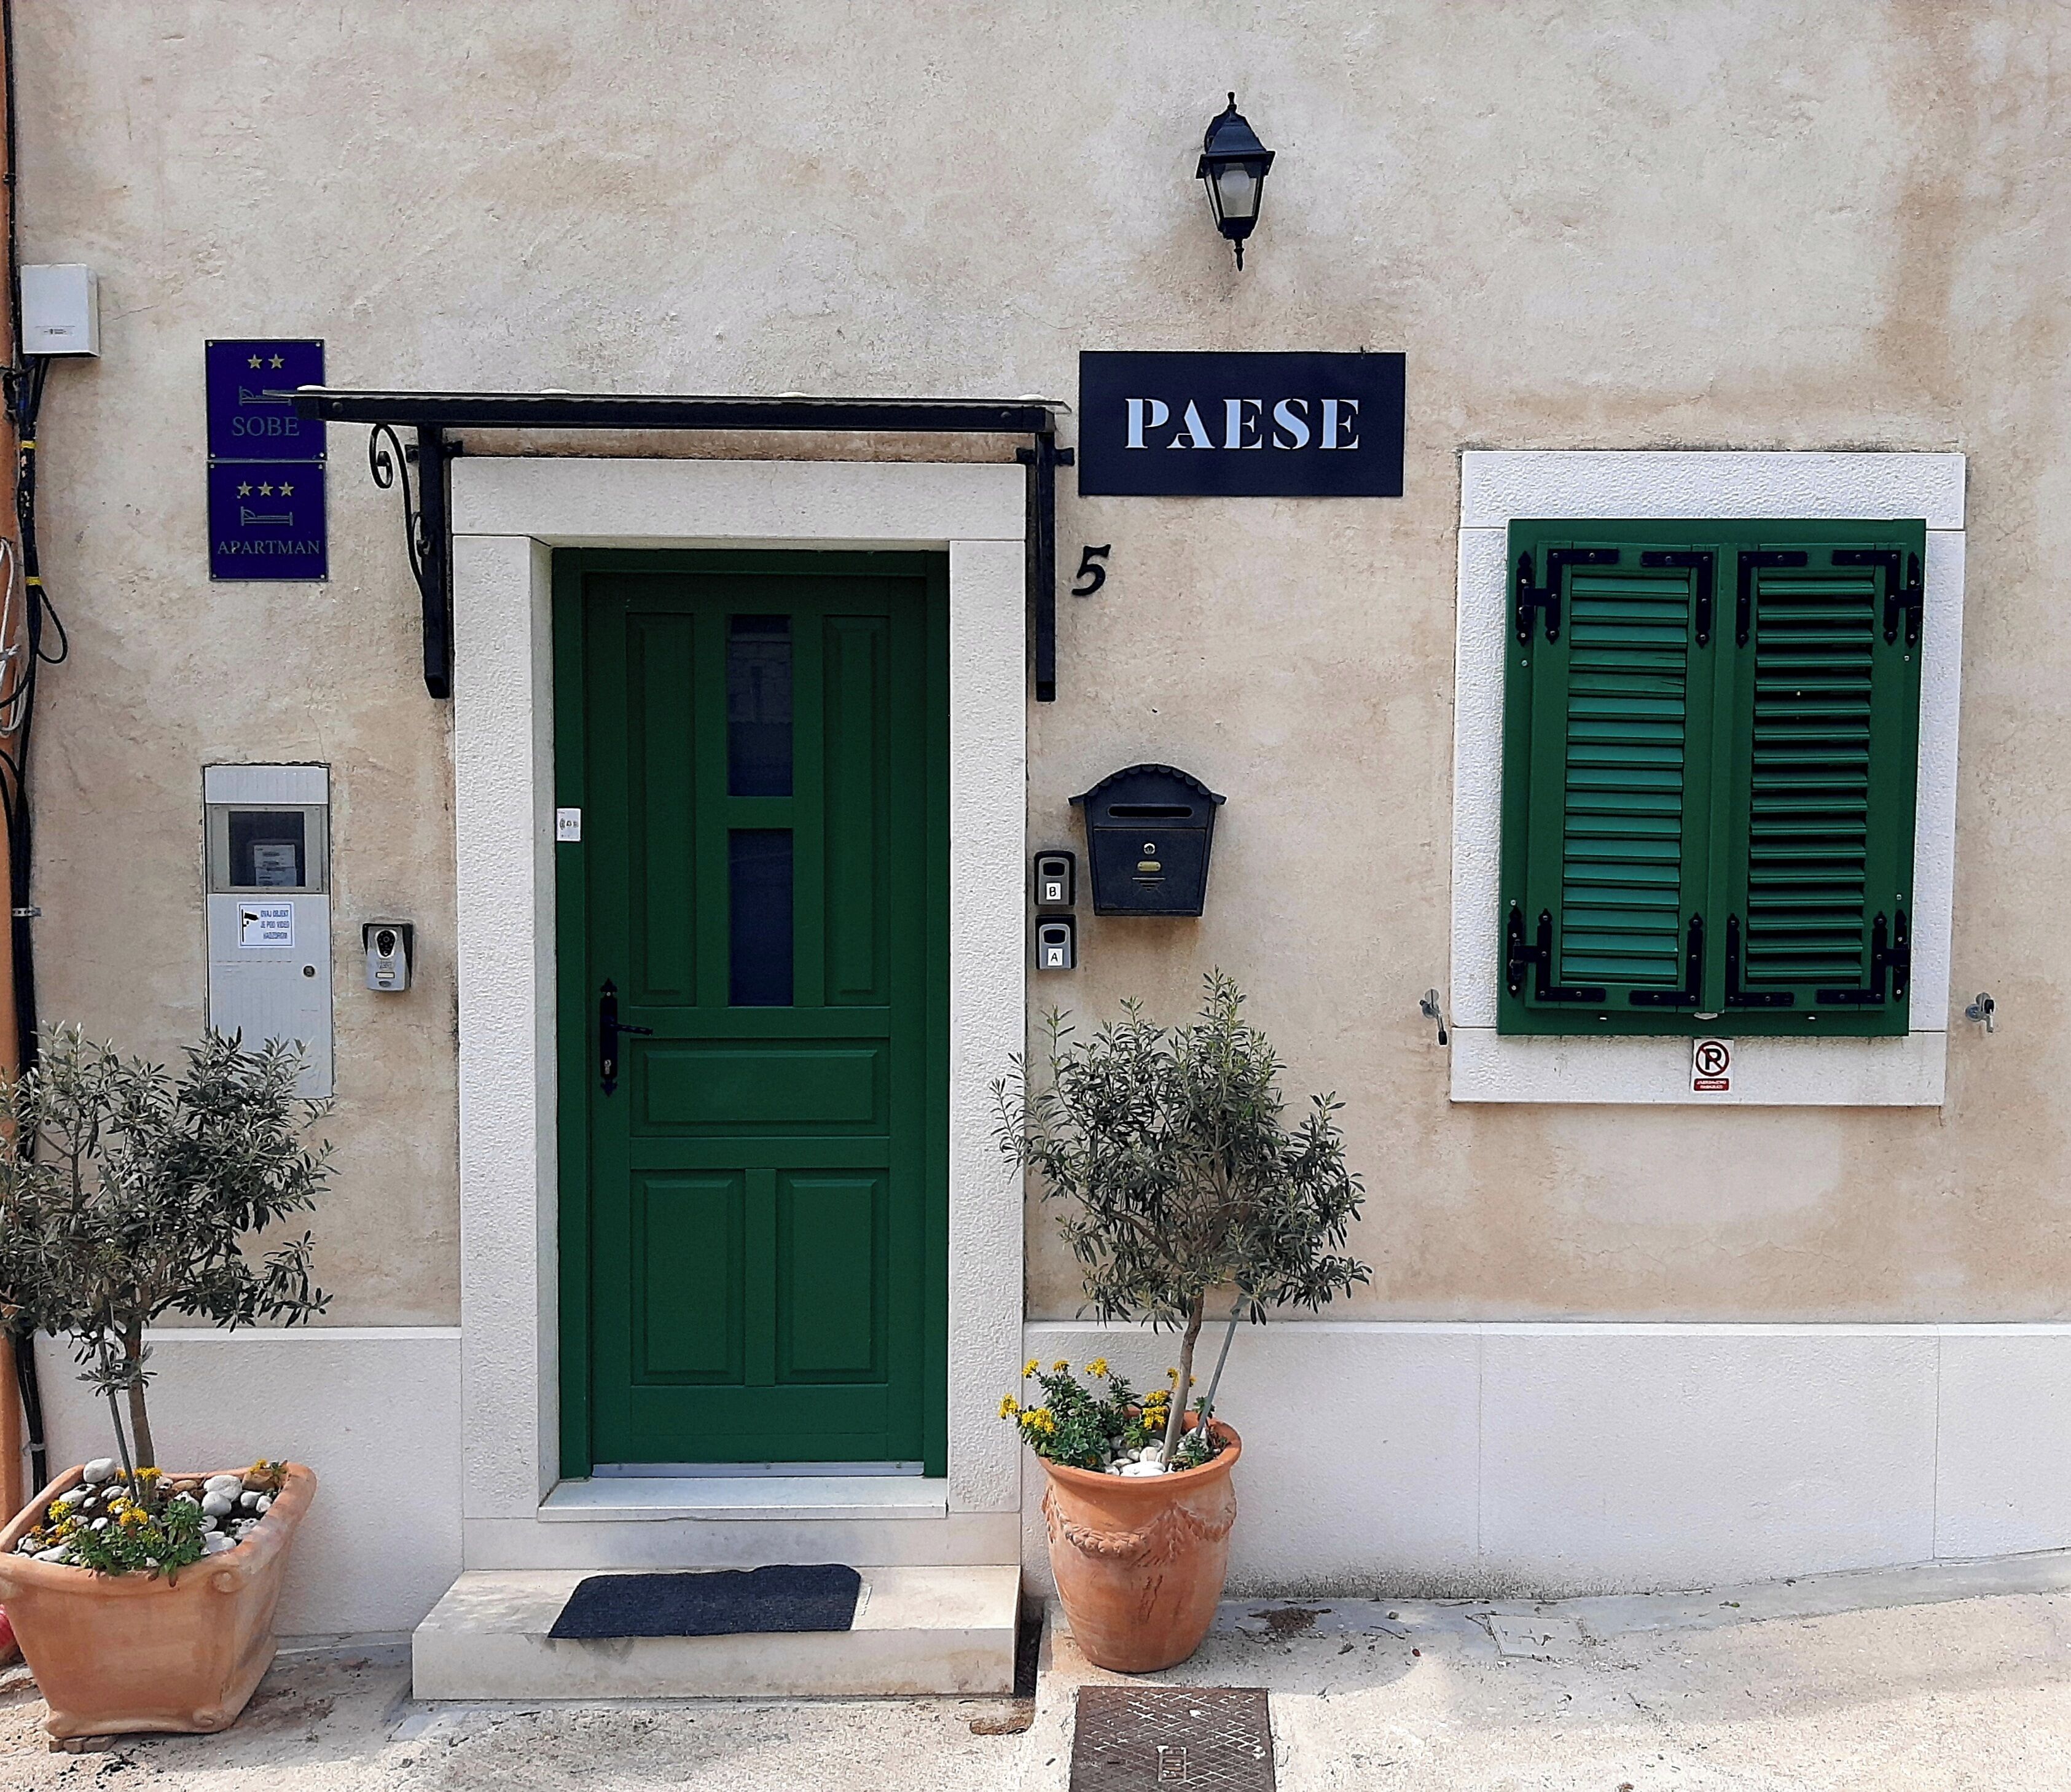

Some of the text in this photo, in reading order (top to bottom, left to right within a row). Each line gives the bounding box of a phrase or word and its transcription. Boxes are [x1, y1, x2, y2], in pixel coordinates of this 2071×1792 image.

[232, 416, 300, 437] SOBE
[1124, 398, 1359, 450] PAESE
[217, 539, 320, 555] APARTMAN
[1071, 544, 1111, 596] 5
[1049, 886, 1057, 897] B
[1051, 952, 1059, 962] A
